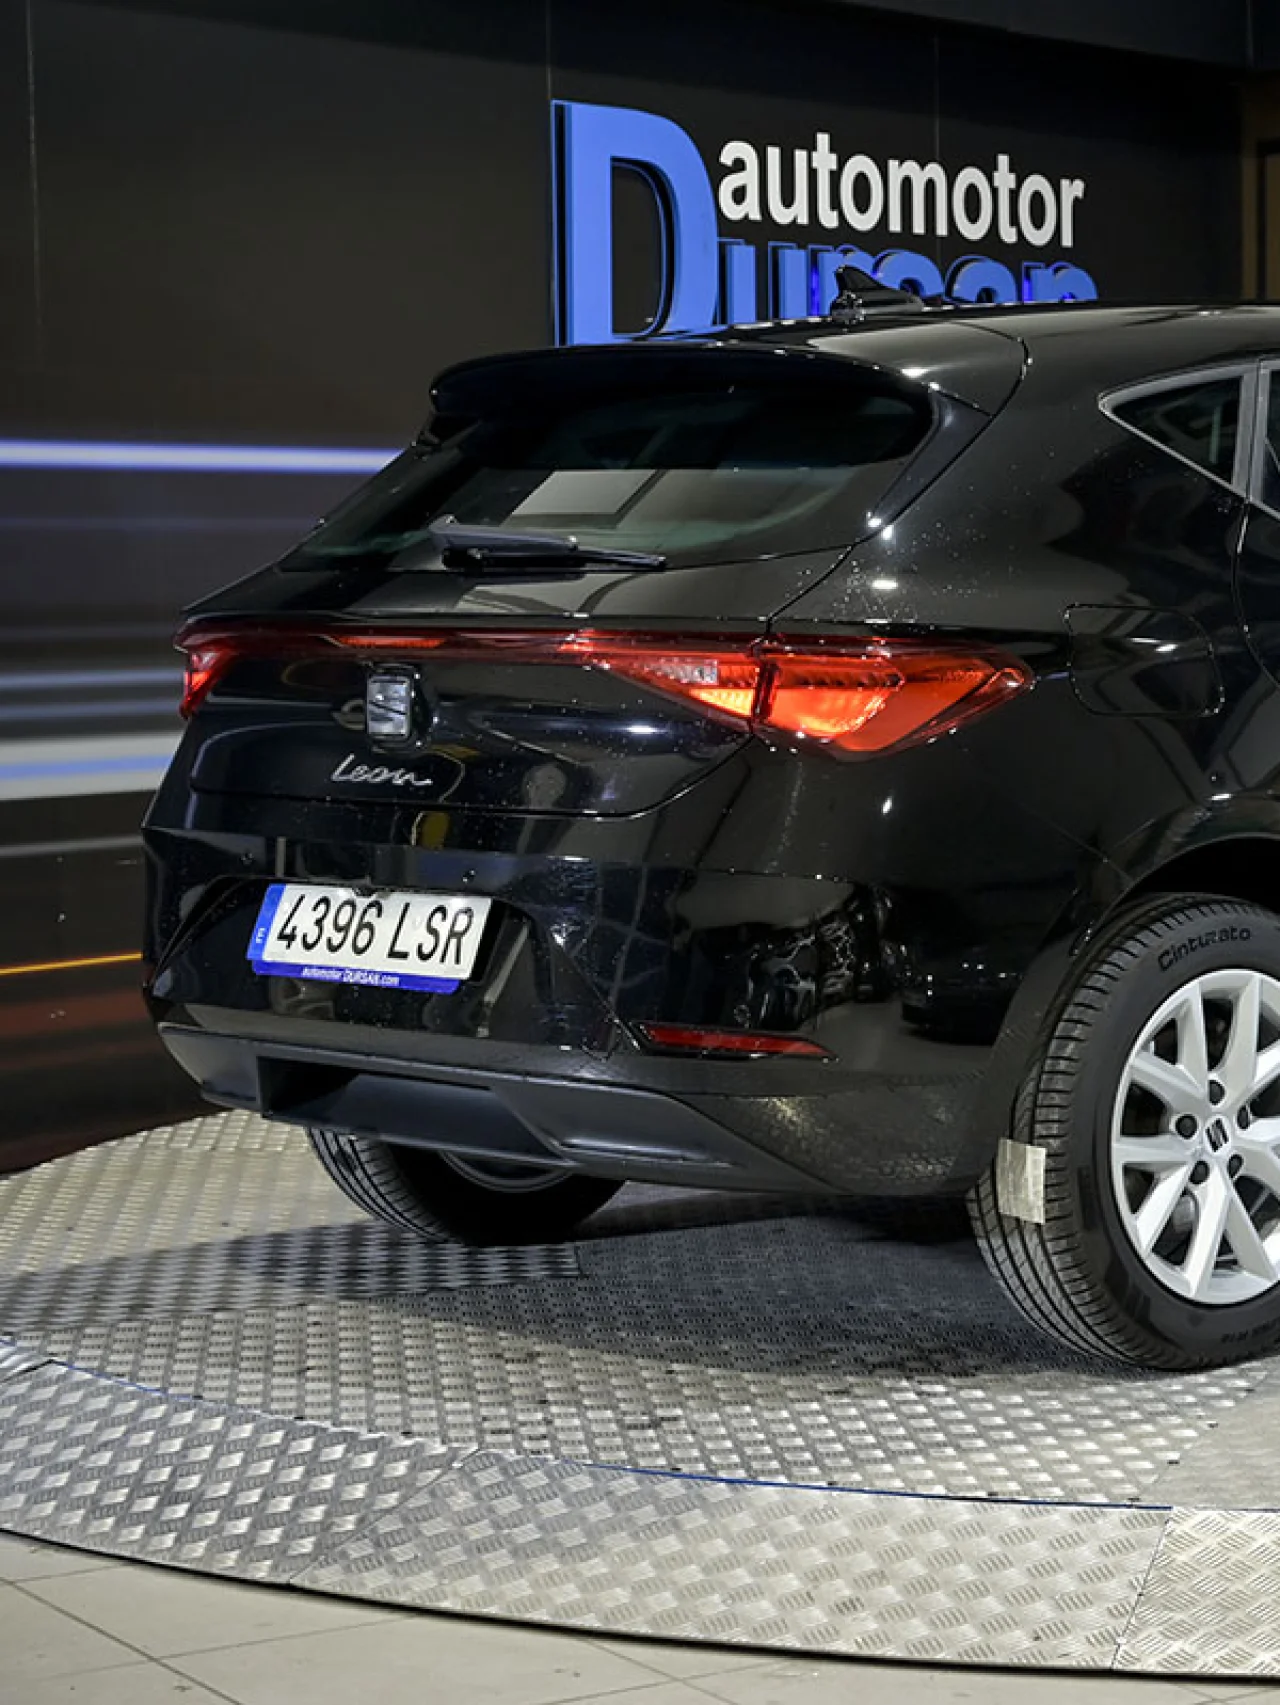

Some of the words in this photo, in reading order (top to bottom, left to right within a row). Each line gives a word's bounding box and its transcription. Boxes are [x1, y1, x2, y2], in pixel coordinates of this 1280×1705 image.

[718, 131, 1086, 248] automotor
[331, 753, 433, 785] Leon
[277, 894, 383, 956] 4396
[387, 902, 474, 965] LSR
[1157, 925, 1251, 973] Cinturato
